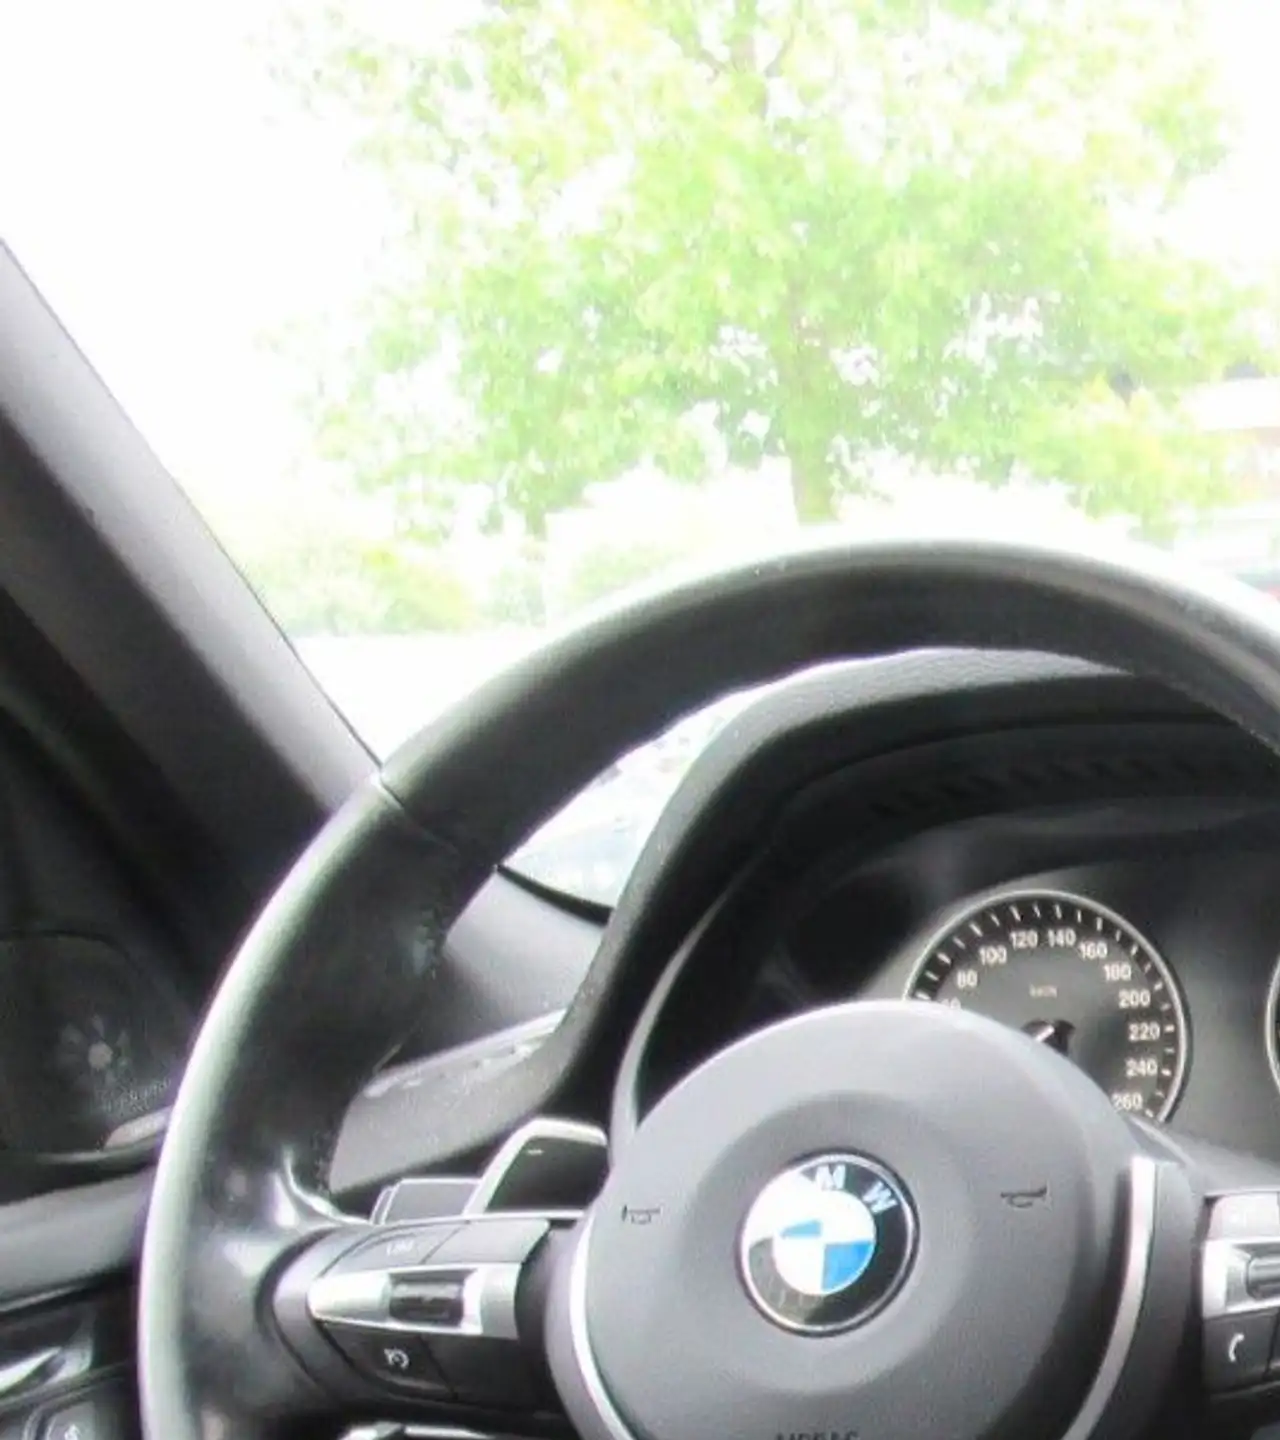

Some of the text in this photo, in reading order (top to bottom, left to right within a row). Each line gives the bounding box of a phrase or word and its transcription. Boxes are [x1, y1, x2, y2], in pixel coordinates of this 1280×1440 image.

[1009, 931, 1038, 949] 120
[1048, 929, 1076, 947] 140
[979, 947, 1008, 965] 100
[1079, 942, 1108, 960] 160
[1118, 990, 1151, 1009] 200
[1128, 1023, 1160, 1041] 220
[1126, 1059, 1158, 1077] 240
[1112, 1093, 1142, 1111] 260
